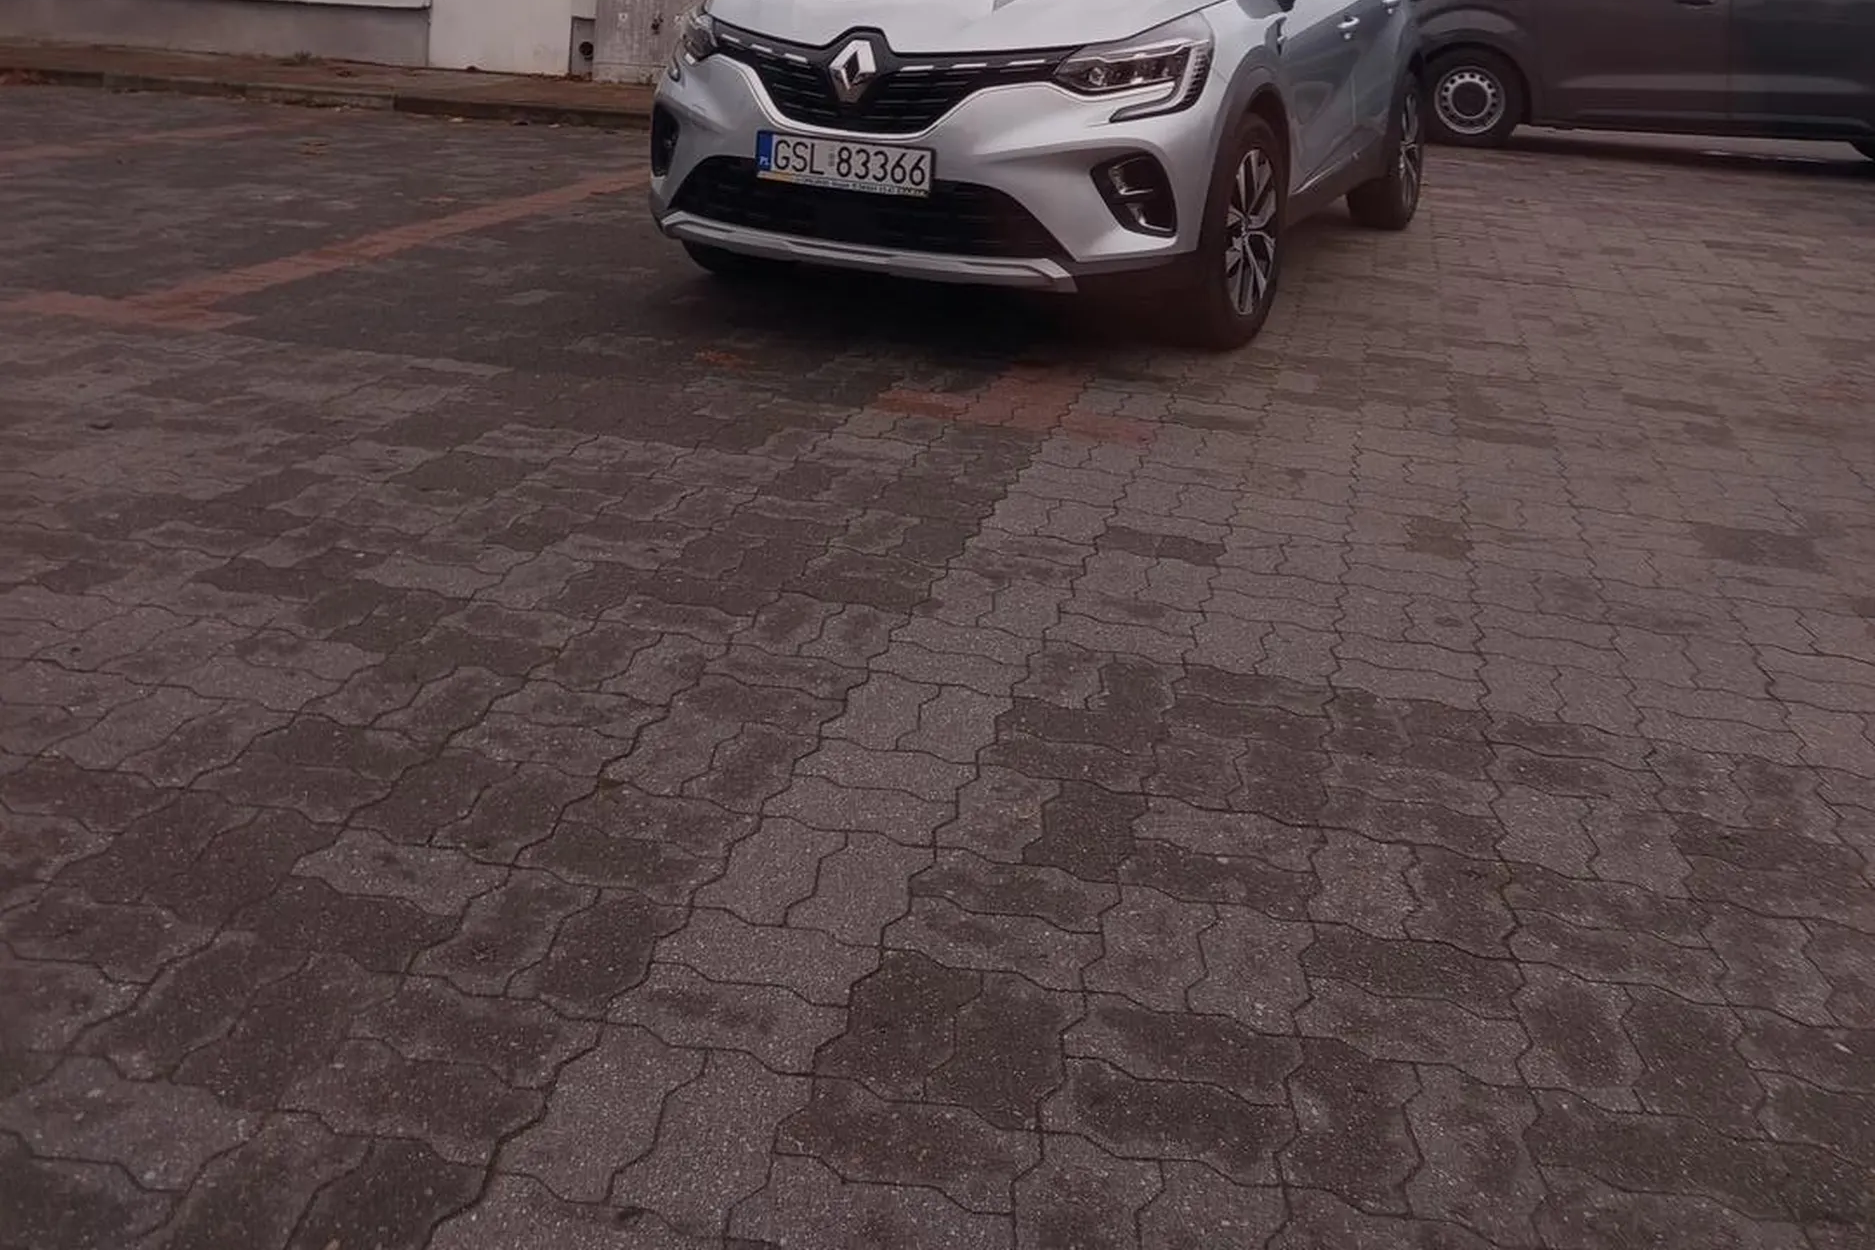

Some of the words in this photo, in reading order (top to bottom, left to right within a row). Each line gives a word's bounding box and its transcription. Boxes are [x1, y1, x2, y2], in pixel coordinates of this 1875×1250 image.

[759, 156, 770, 166] PL
[774, 139, 824, 175] GSL
[837, 146, 926, 186] 83366
